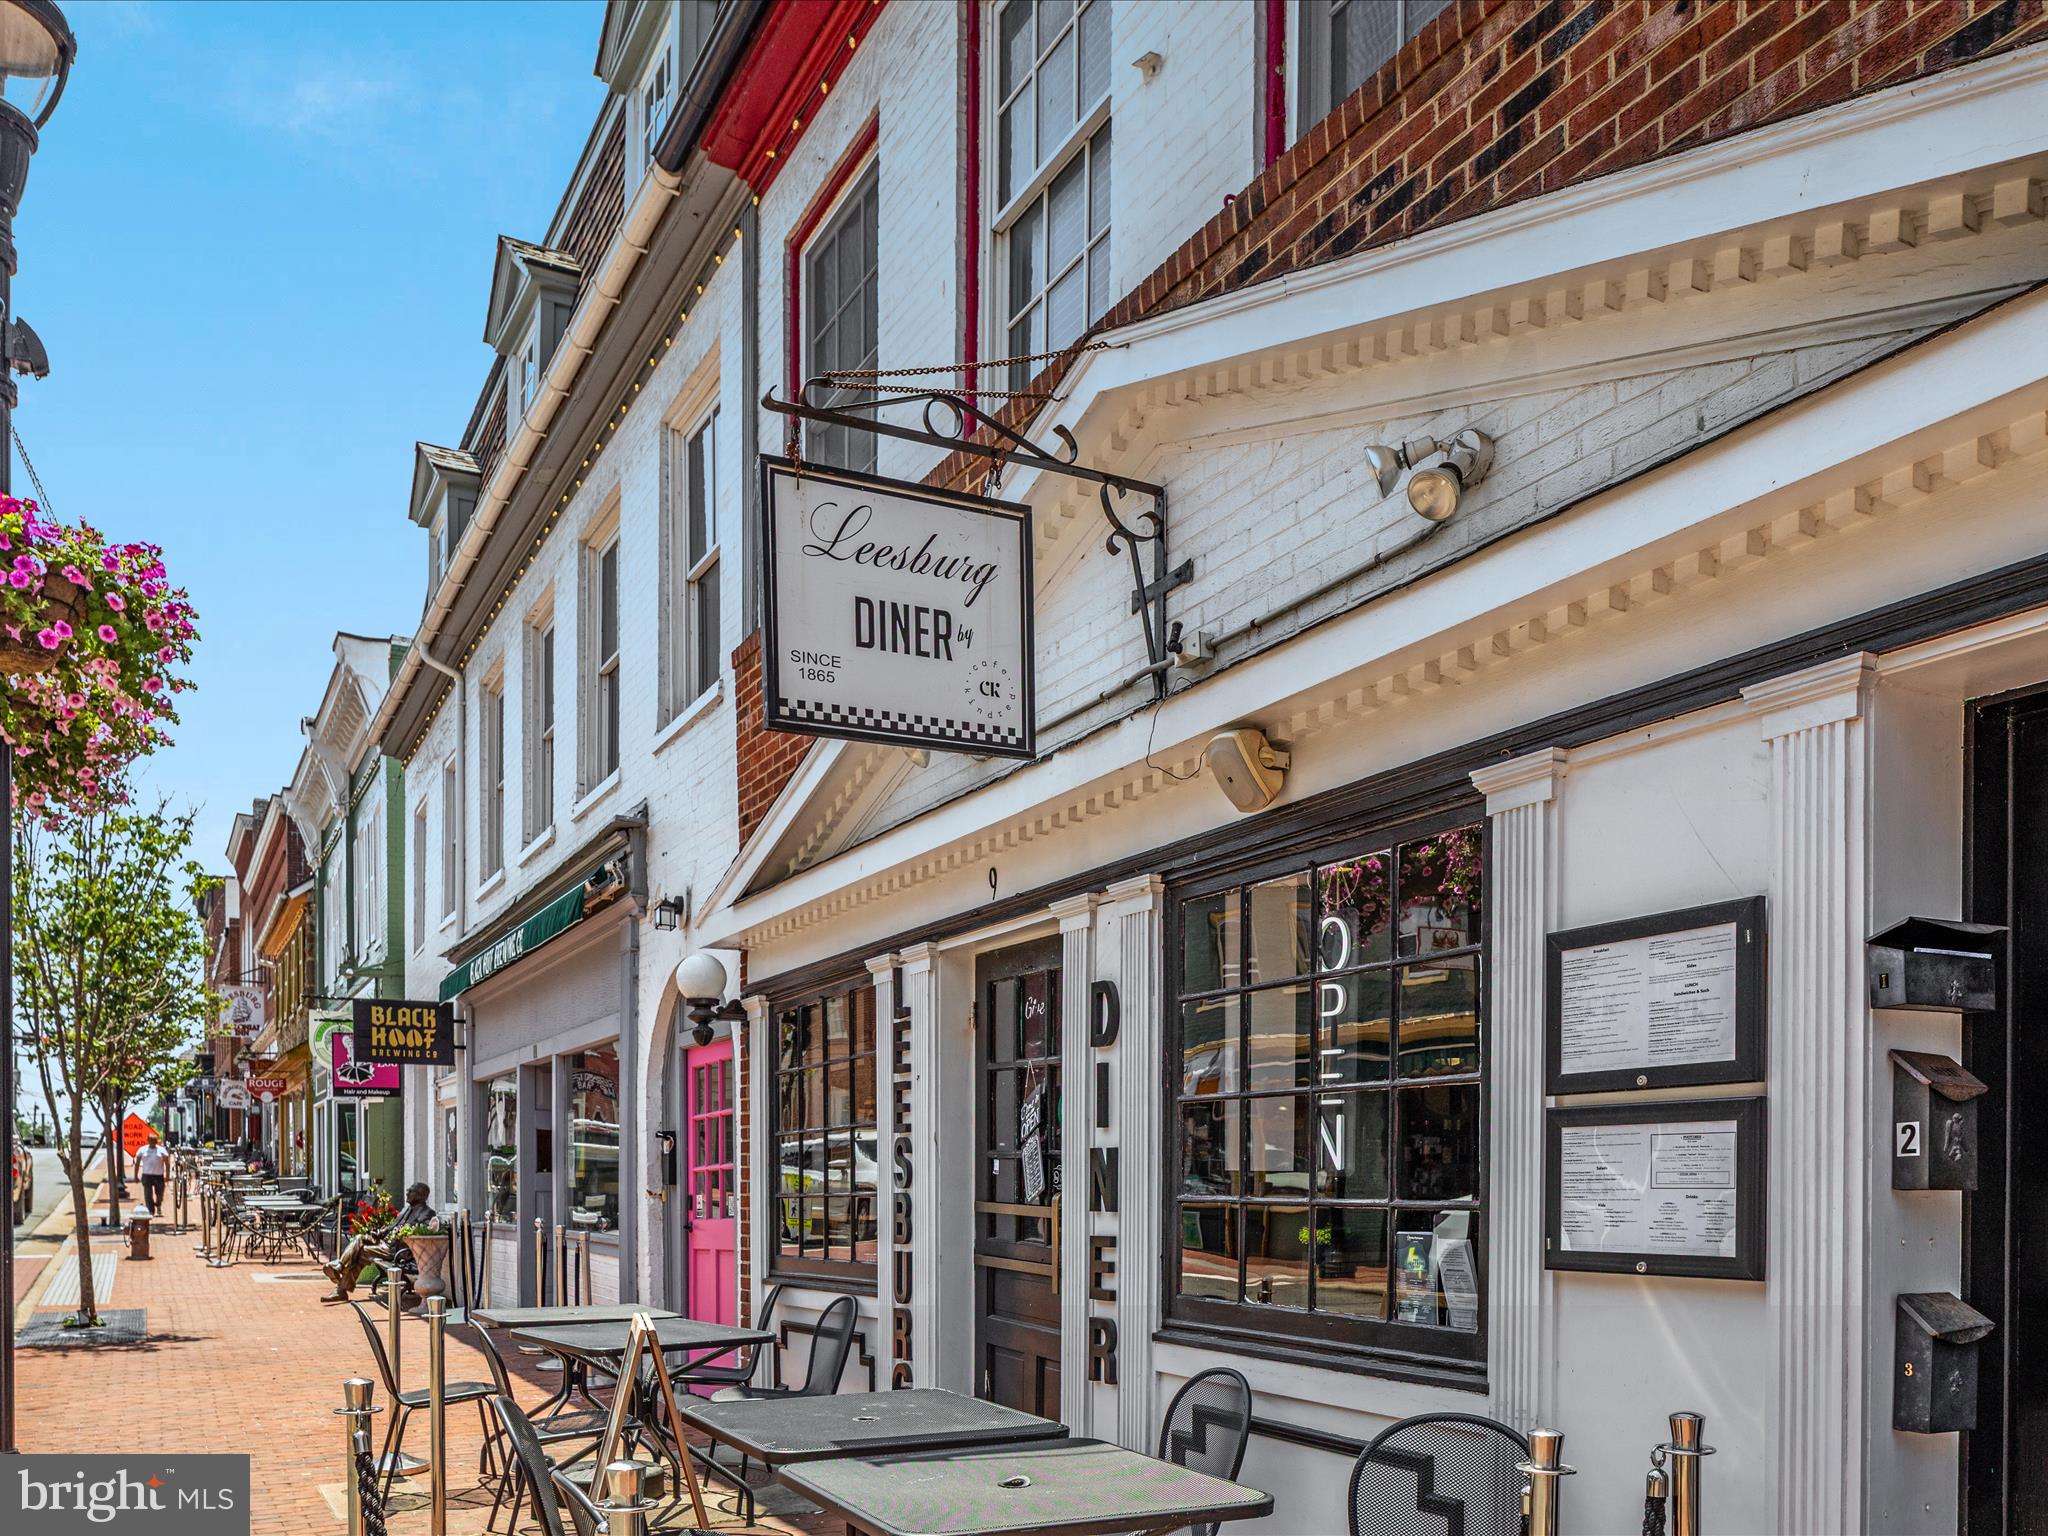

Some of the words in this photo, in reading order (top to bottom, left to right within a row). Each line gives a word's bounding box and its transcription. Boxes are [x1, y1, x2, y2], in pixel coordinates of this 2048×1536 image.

[802, 502, 998, 608] Leesburg
[854, 595, 953, 661] DINER
[957, 624, 974, 649] by
[790, 650, 842, 669] SINCE
[798, 667, 836, 684] 1865
[988, 867, 998, 900] 9
[371, 1005, 437, 1029] BLACK
[371, 1027, 437, 1050] HOOF
[1320, 916, 1351, 1171] OPEN
[371, 1049, 421, 1058] BREWING
[249, 1079, 284, 1088] ROUGE
[1901, 1124, 1916, 1154] 2
[892, 967, 914, 1391] LEESBURG
[1087, 980, 1121, 1385] DINER
[1904, 1362, 1913, 1377] 3
